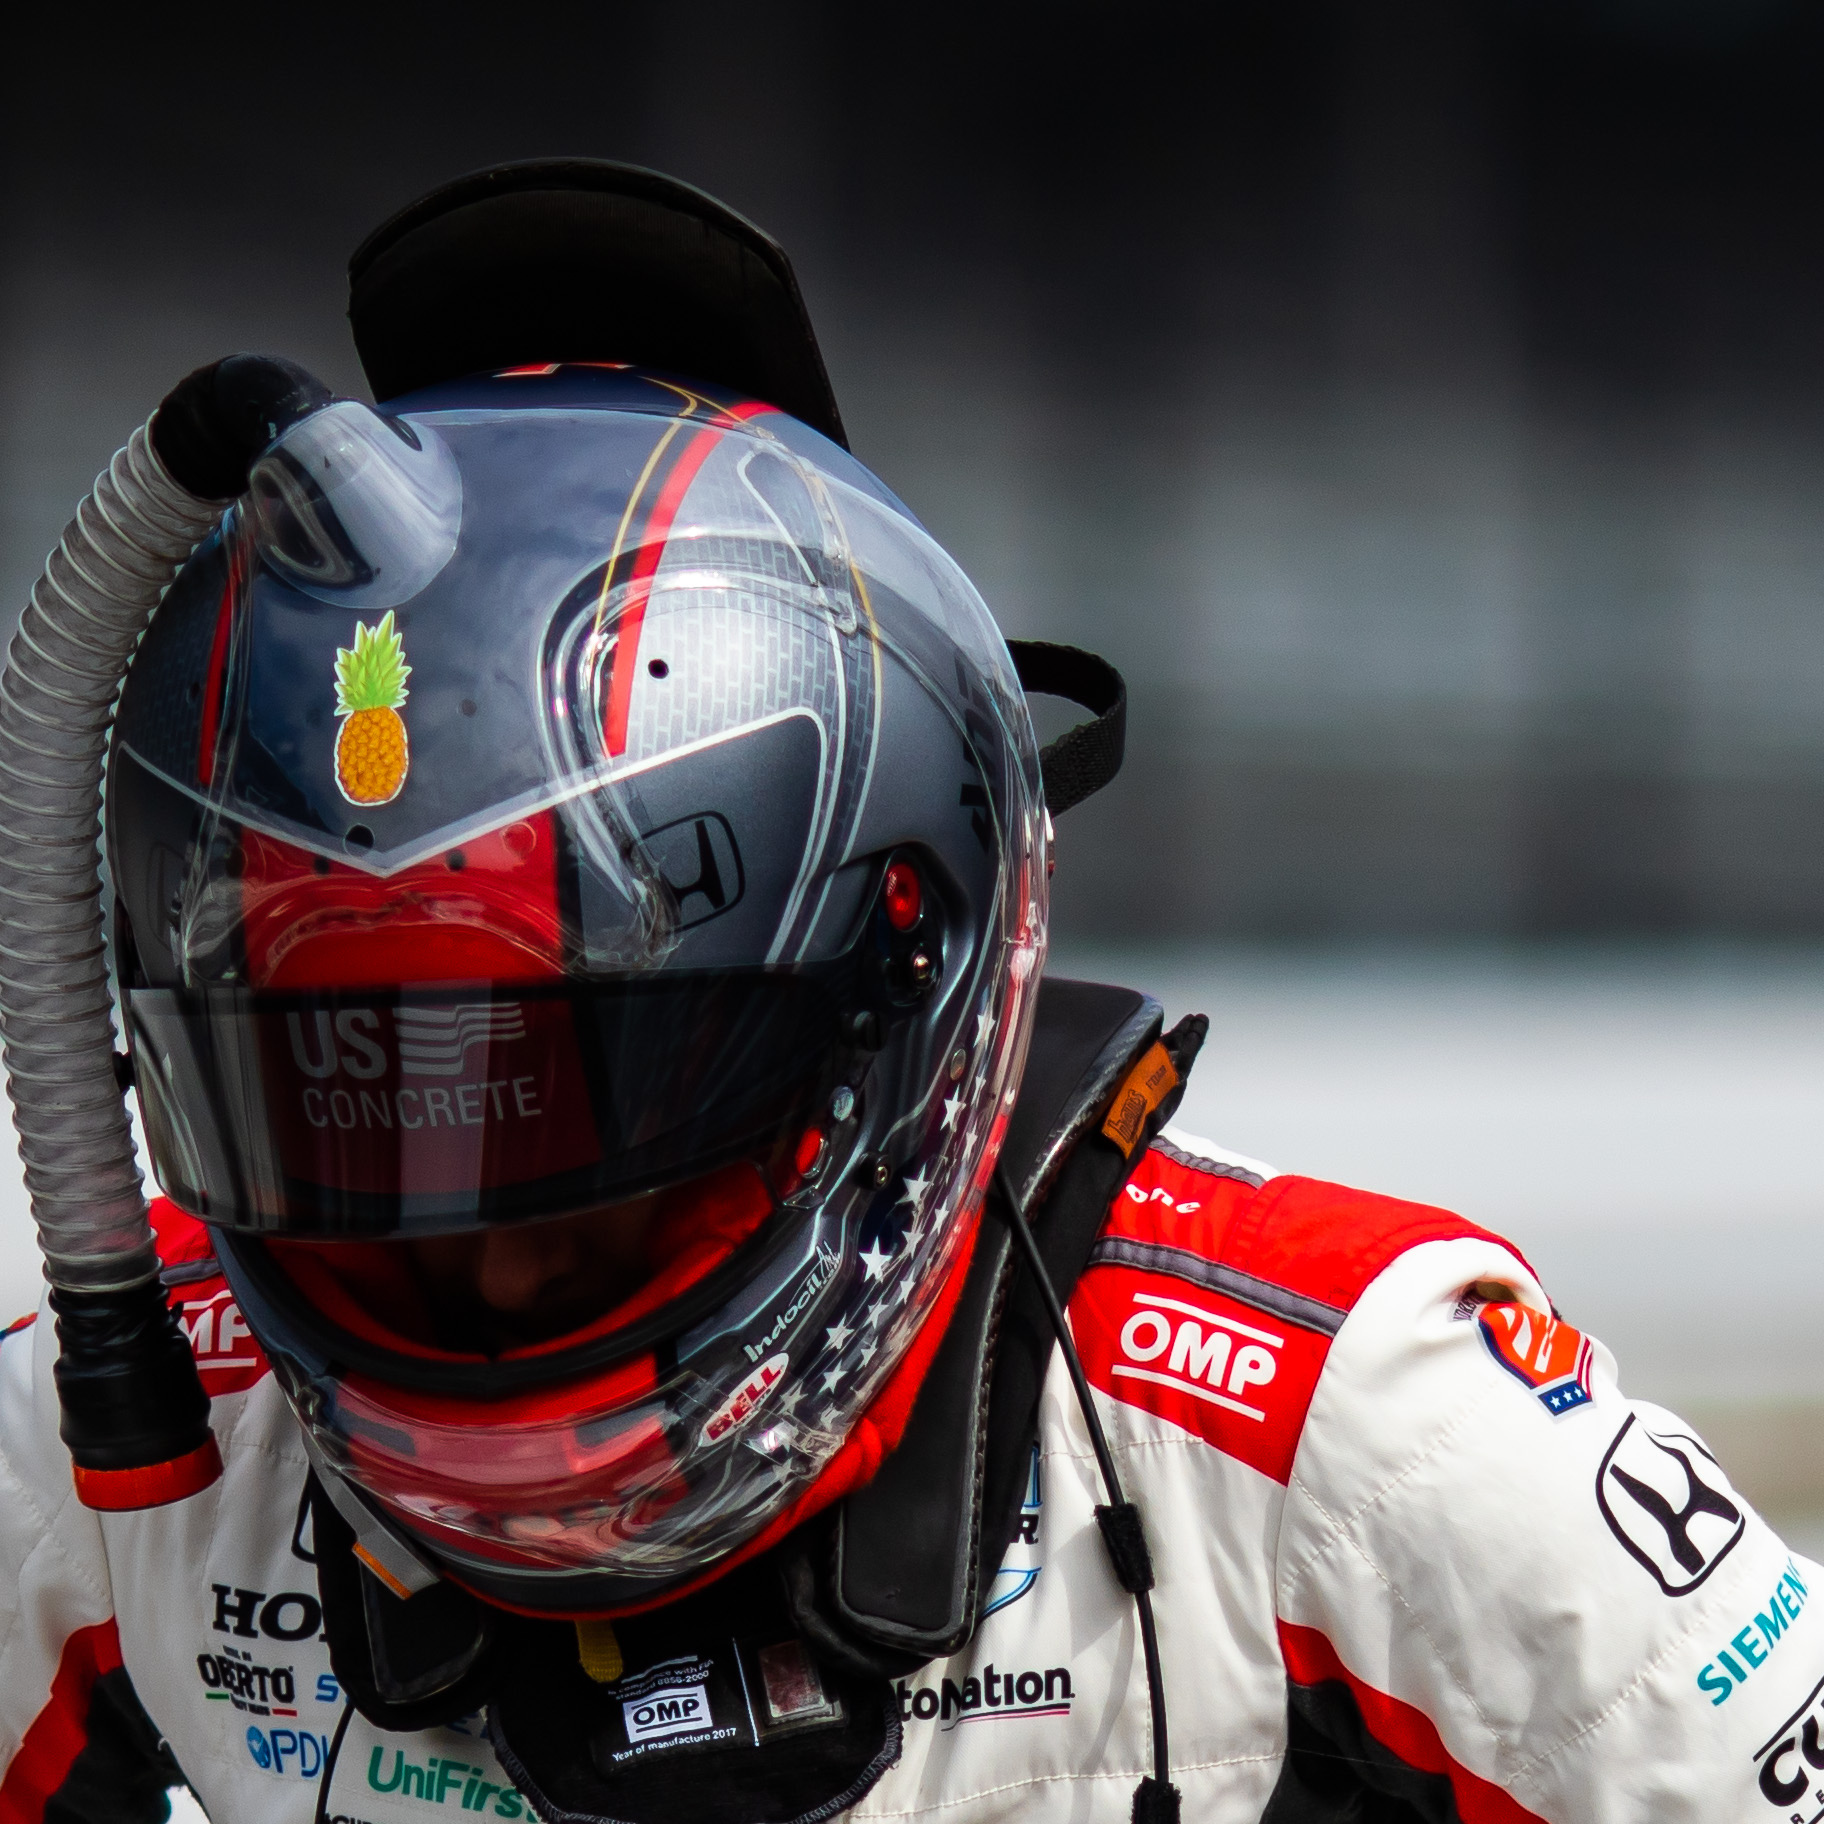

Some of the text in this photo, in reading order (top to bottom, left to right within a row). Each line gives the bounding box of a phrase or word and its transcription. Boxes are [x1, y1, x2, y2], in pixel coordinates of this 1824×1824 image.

[286, 1006, 388, 1080] US
[302, 1075, 543, 1130] CONCRETE
[177, 1303, 252, 1354] MP
[1120, 1310, 1277, 1396] OMP
[211, 1583, 327, 1643] HO
[1697, 1556, 1809, 1708] SIEMEN
[633, 1698, 700, 1726] OMP
[896, 1663, 1075, 1722] toNation
[612, 1727, 737, 1763] Year of manufacture 2017
